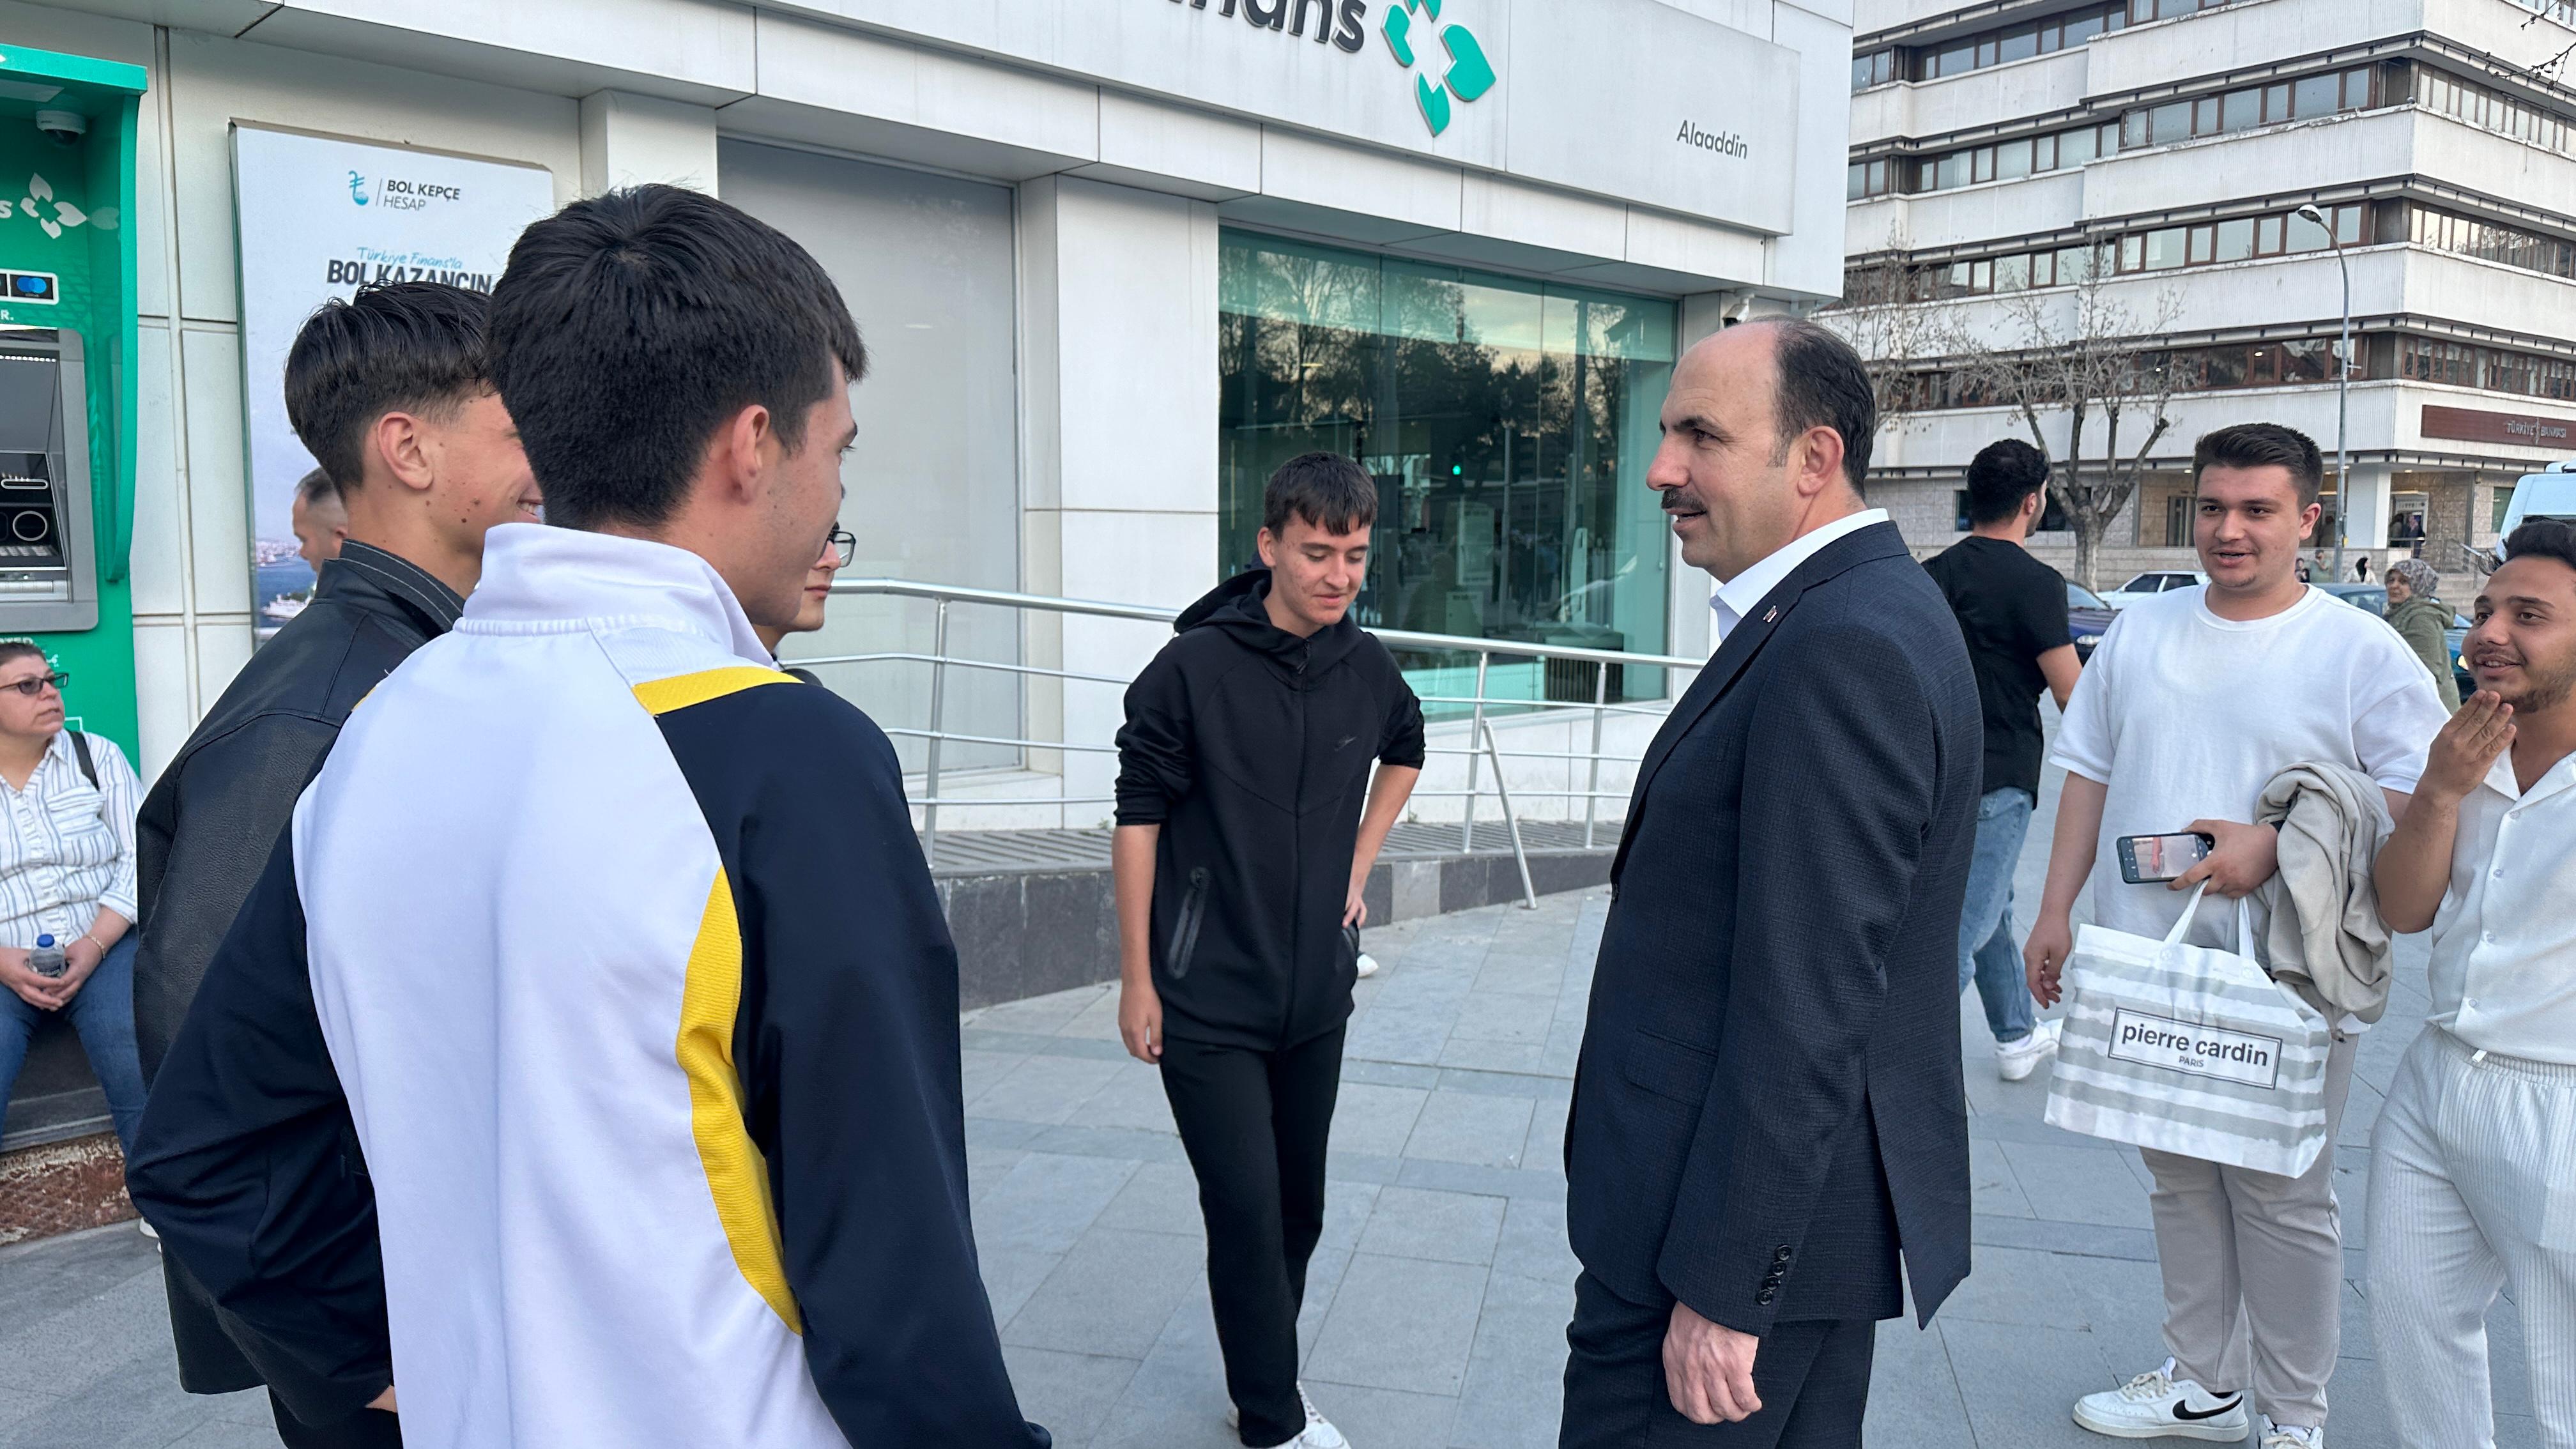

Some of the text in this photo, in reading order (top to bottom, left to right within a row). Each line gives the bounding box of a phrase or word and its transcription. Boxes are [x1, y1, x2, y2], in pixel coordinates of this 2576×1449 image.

[1676, 119, 1747, 159] Alaaddin
[387, 180, 461, 201] BOL KEPÇE
[383, 195, 426, 211] HESAP
[326, 259, 371, 286] BOL
[2506, 420, 2535, 436] TÜRKİYE
[2122, 1023, 2267, 1067] pierre cardin
[2179, 1055, 2204, 1068] PARIS
